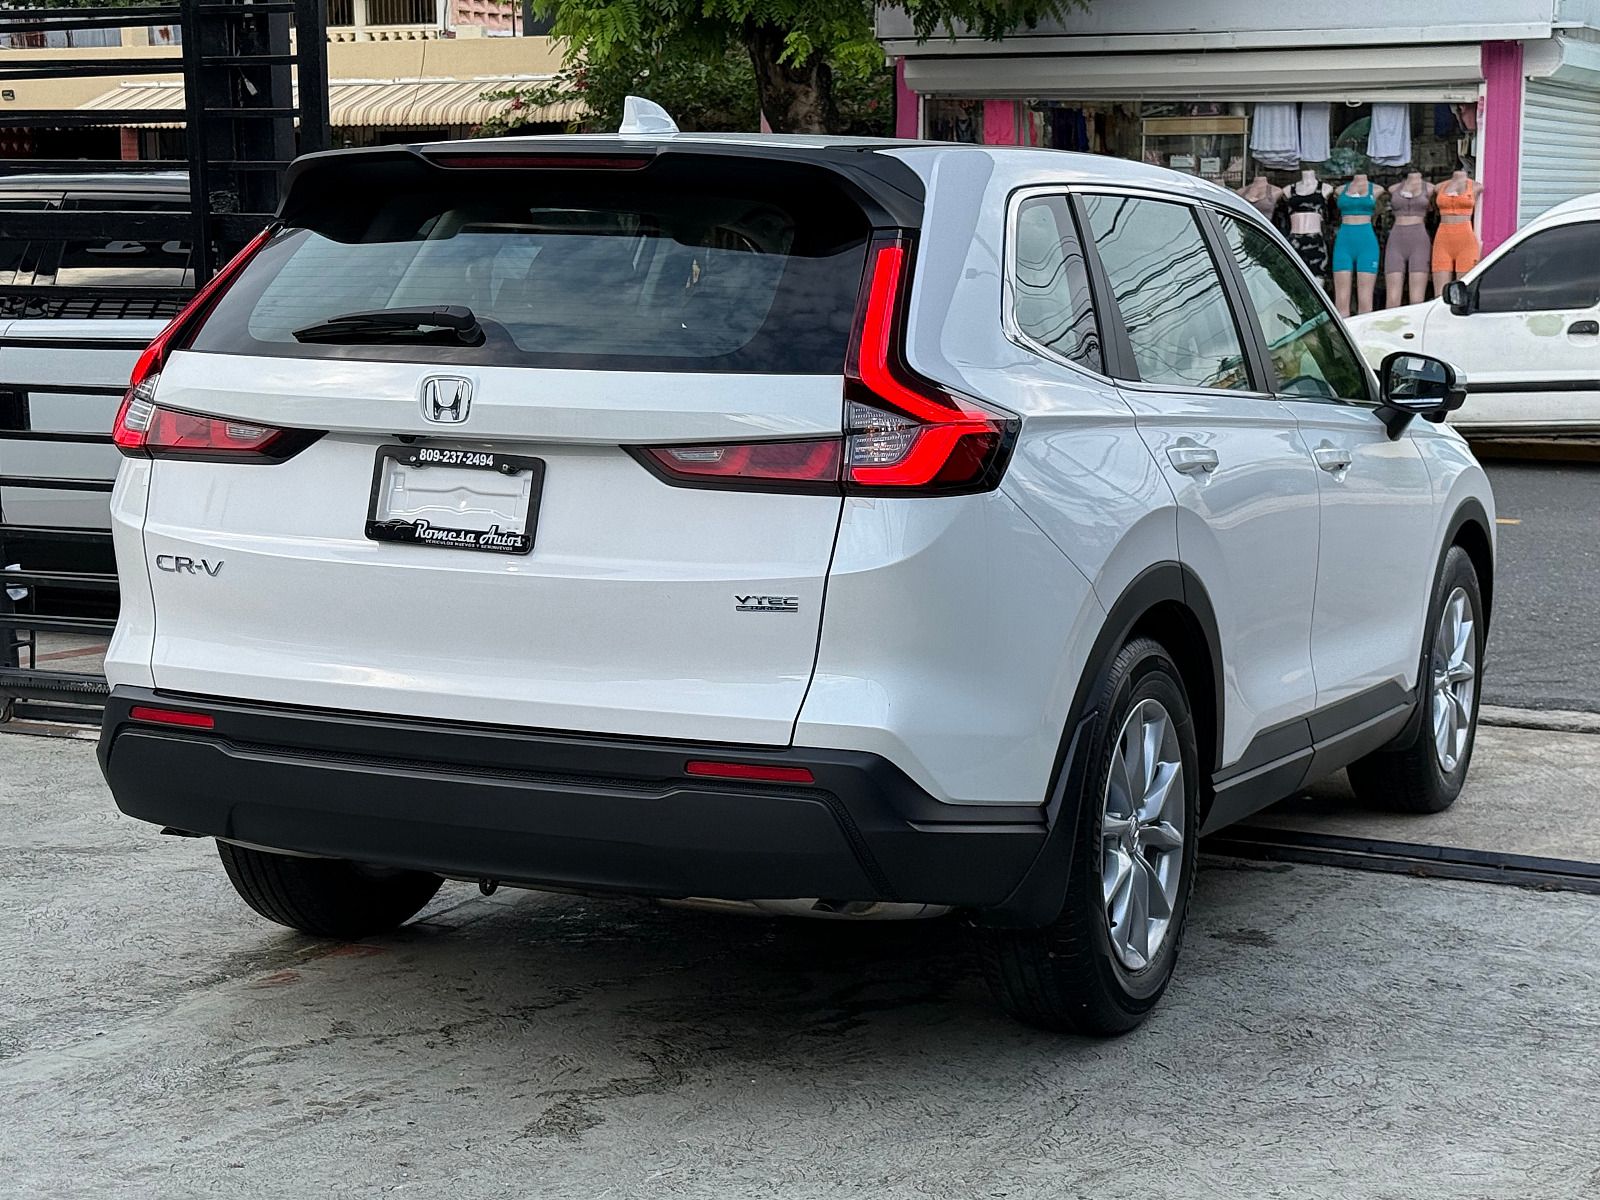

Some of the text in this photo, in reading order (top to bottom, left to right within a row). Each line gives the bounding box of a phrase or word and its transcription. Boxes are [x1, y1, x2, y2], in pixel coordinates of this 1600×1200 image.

[419, 448, 494, 467] 809-237-2494
[415, 520, 523, 547] Romesa Autos
[156, 554, 225, 577] CR-V
[734, 595, 799, 606] VTEC
